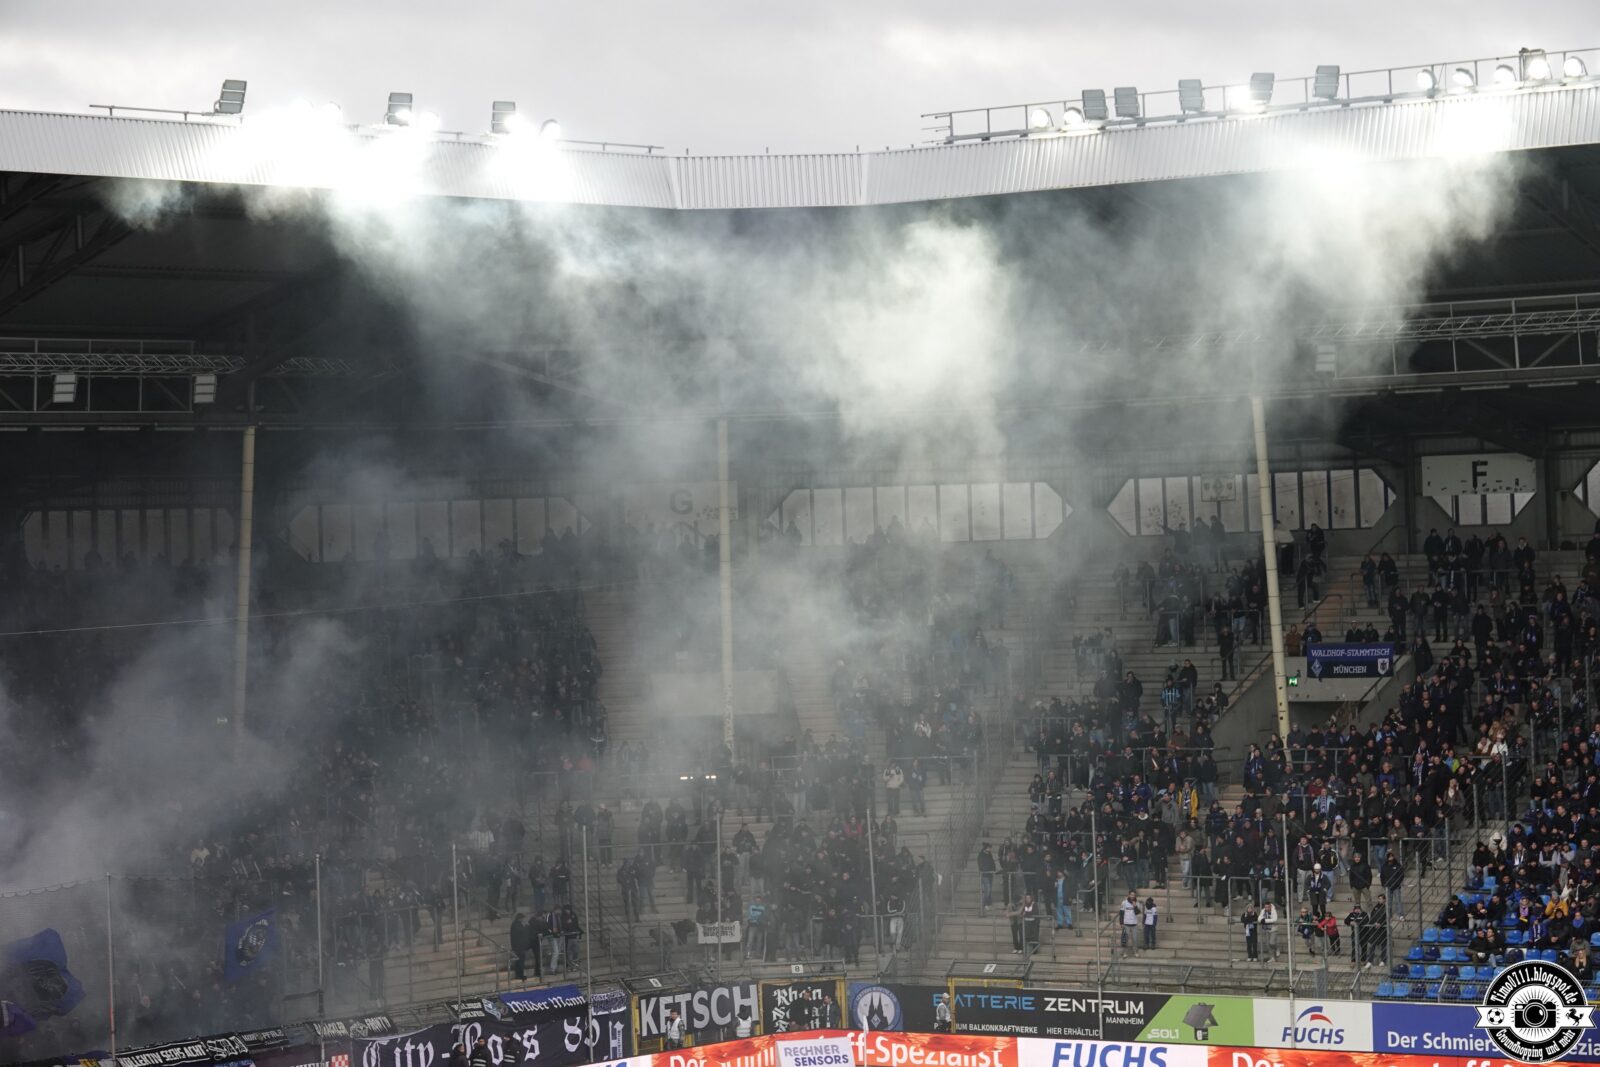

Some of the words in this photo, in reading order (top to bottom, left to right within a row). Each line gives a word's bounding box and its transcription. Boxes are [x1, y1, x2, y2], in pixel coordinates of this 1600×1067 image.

[1471, 460, 1488, 489] F
[670, 490, 694, 515] G
[1311, 648, 1390, 657] WALDHOF-STAMMTISCH
[1333, 665, 1367, 674] MÜNCHEN
[506, 999, 550, 1014] Wilder
[548, 995, 586, 1010] Mann
[640, 984, 760, 1037] KETSCH
[1044, 997, 1144, 1015] ZENTRUM
[934, 1022, 968, 1034] PIUM
[969, 1023, 1038, 1034] BALKONKRAFTWERKE
[1047, 1027, 1061, 1035] HIER
[1063, 1026, 1101, 1037] ERHÄLTLIC
[1106, 1017, 1144, 1025] MANNHEIM
[1281, 1026, 1345, 1045] FUCHS
[1387, 1031, 1417, 1049] Der
[784, 1044, 840, 1057] RECHNER
[1052, 1042, 1169, 1067] FUCHS
[794, 1054, 849, 1067] SENSORS
